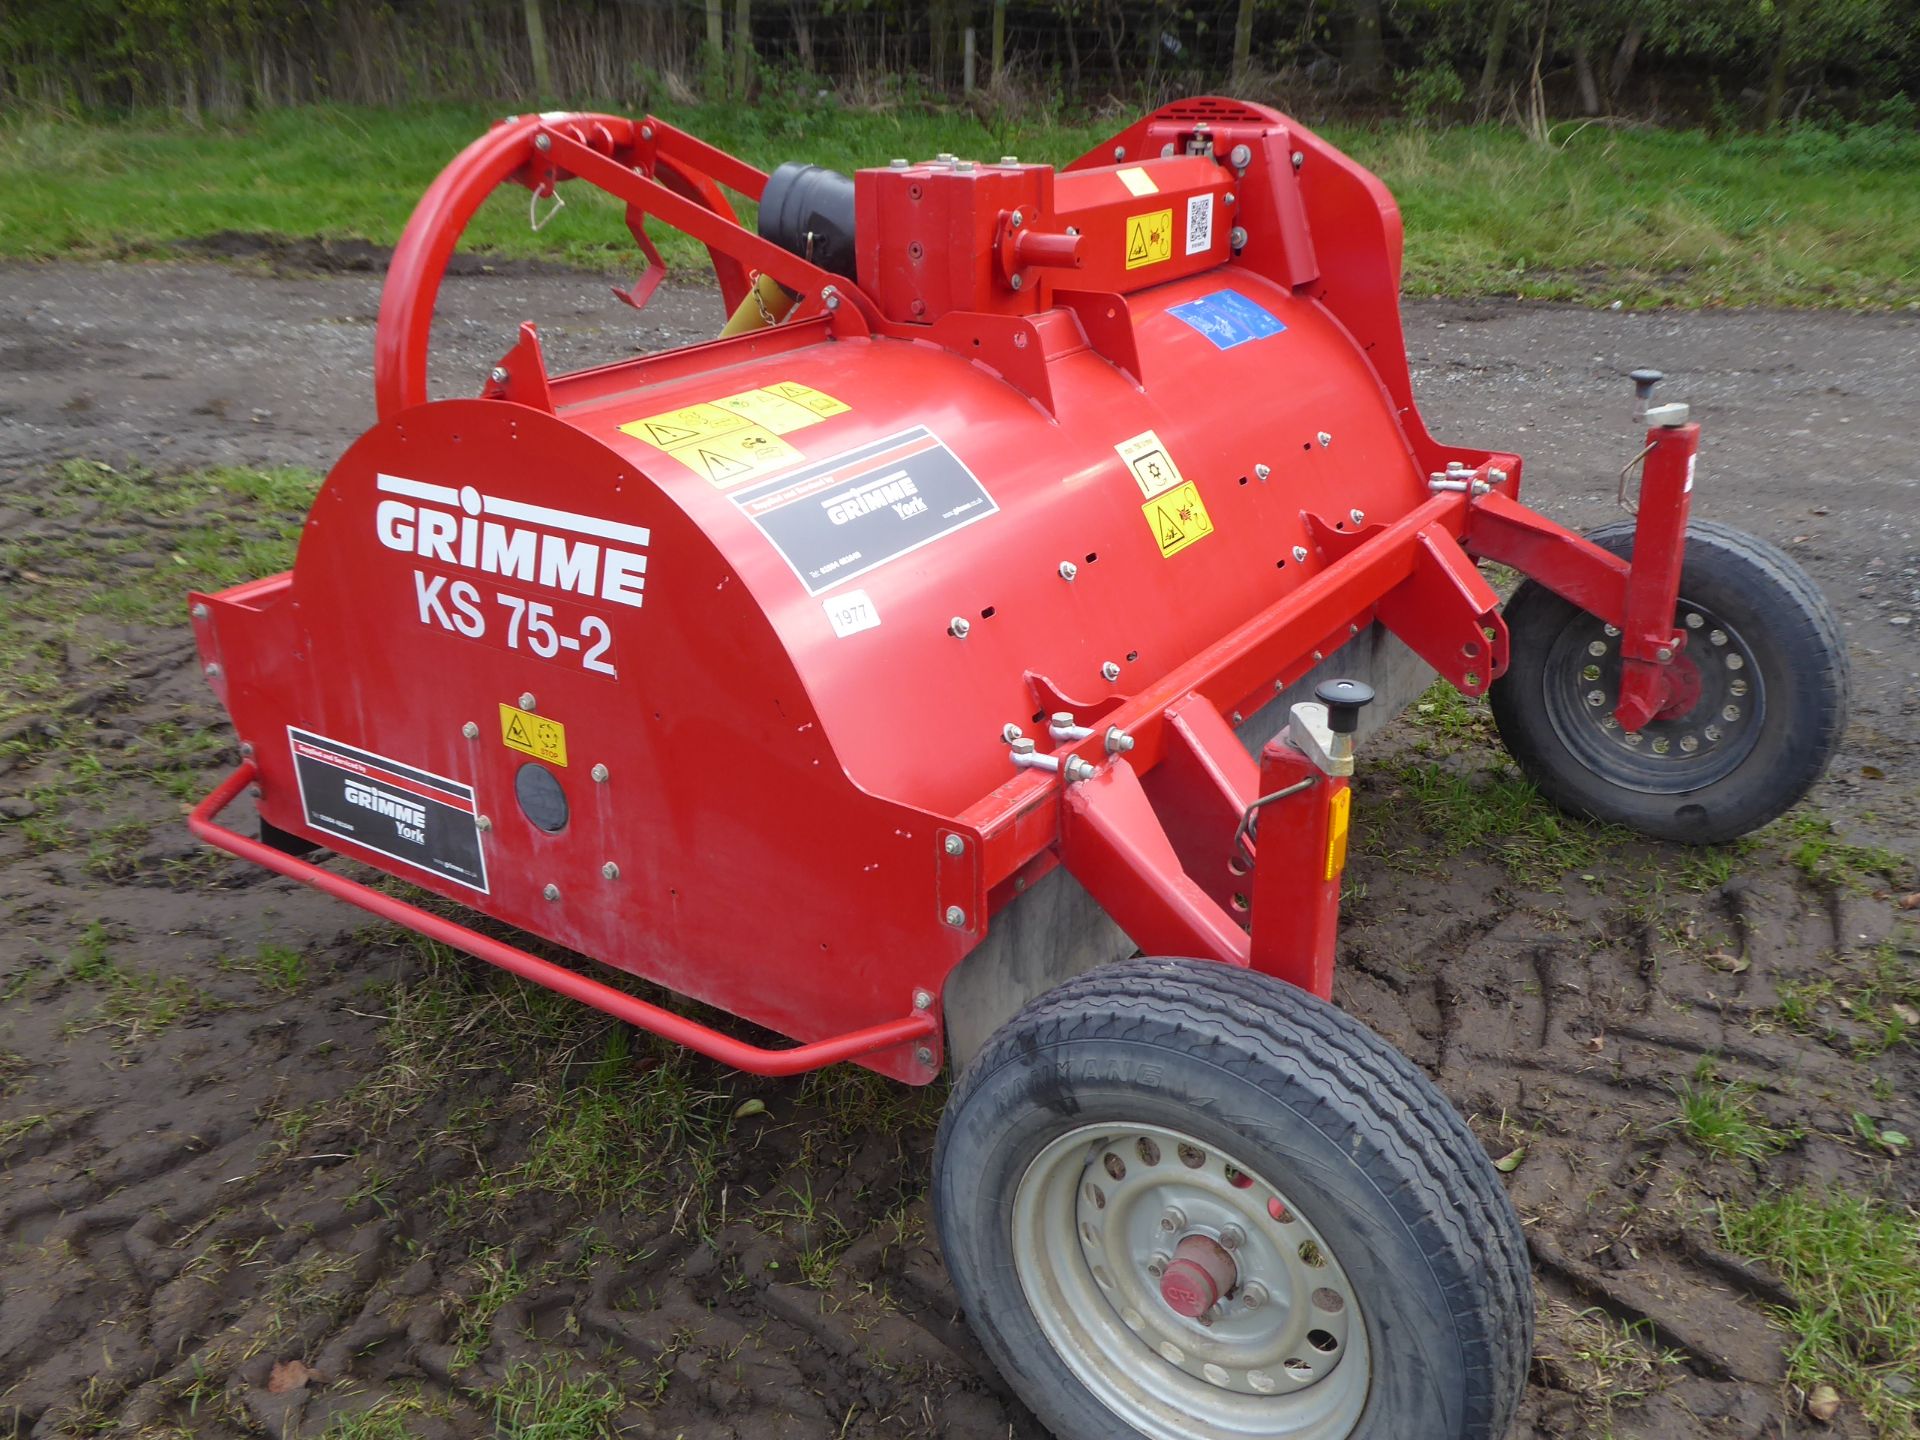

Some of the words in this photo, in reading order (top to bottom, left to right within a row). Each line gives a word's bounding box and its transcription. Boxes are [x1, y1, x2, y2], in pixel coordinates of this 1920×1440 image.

[827, 471, 918, 526] GRIMME
[892, 495, 928, 520] York
[376, 484, 648, 608] GRIMME
[413, 570, 485, 639] KS
[496, 593, 615, 676] 75-2
[834, 604, 867, 626] 1977
[540, 747, 559, 759] STOP
[344, 785, 426, 828] GRIMME
[395, 821, 425, 844] York
